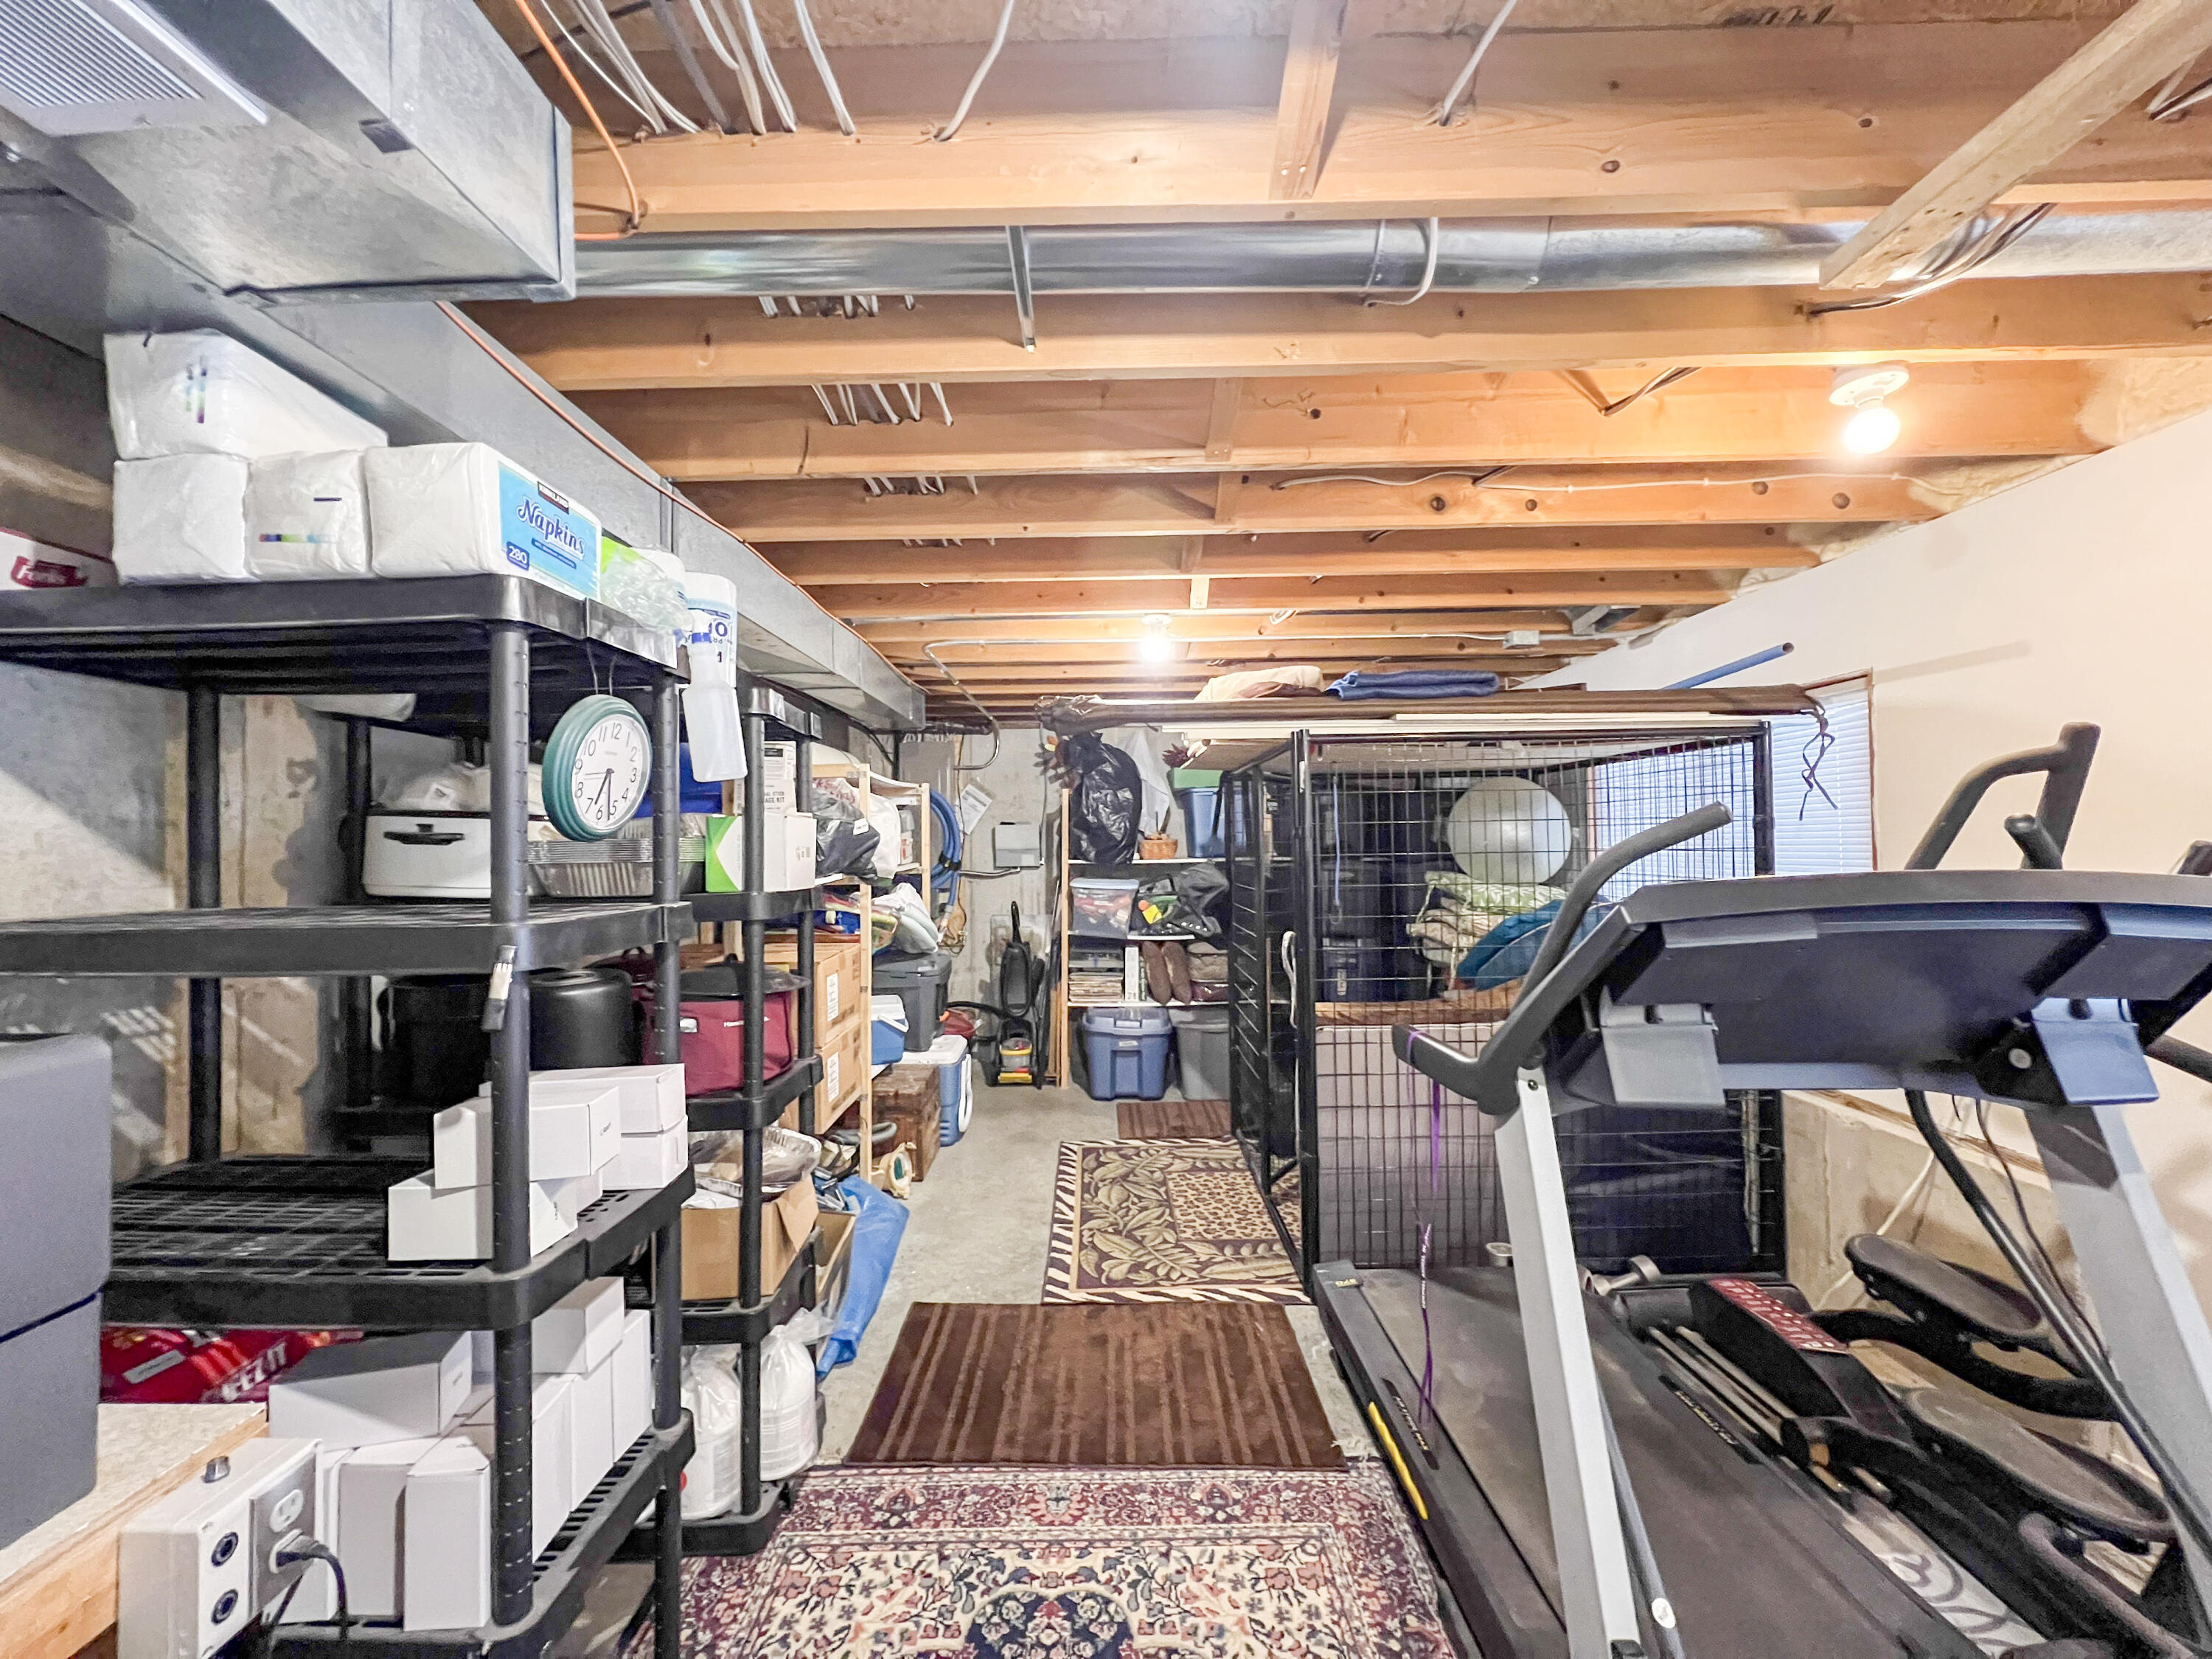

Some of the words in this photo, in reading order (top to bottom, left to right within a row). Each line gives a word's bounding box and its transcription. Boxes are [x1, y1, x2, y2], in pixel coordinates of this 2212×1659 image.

[517, 498, 585, 555] Napkins
[509, 546, 527, 564] 280
[599, 726, 608, 742] 11
[611, 722, 622, 740] 12
[626, 731, 630, 748] 1
[583, 737, 597, 757] 10
[630, 746, 638, 762] 2
[574, 758, 583, 776] 9
[630, 767, 638, 783] 3
[574, 782, 584, 799] 8
[622, 787, 629, 803] 4
[585, 797, 594, 815] 7
[596, 804, 604, 821] 6
[610, 800, 619, 816] 5
